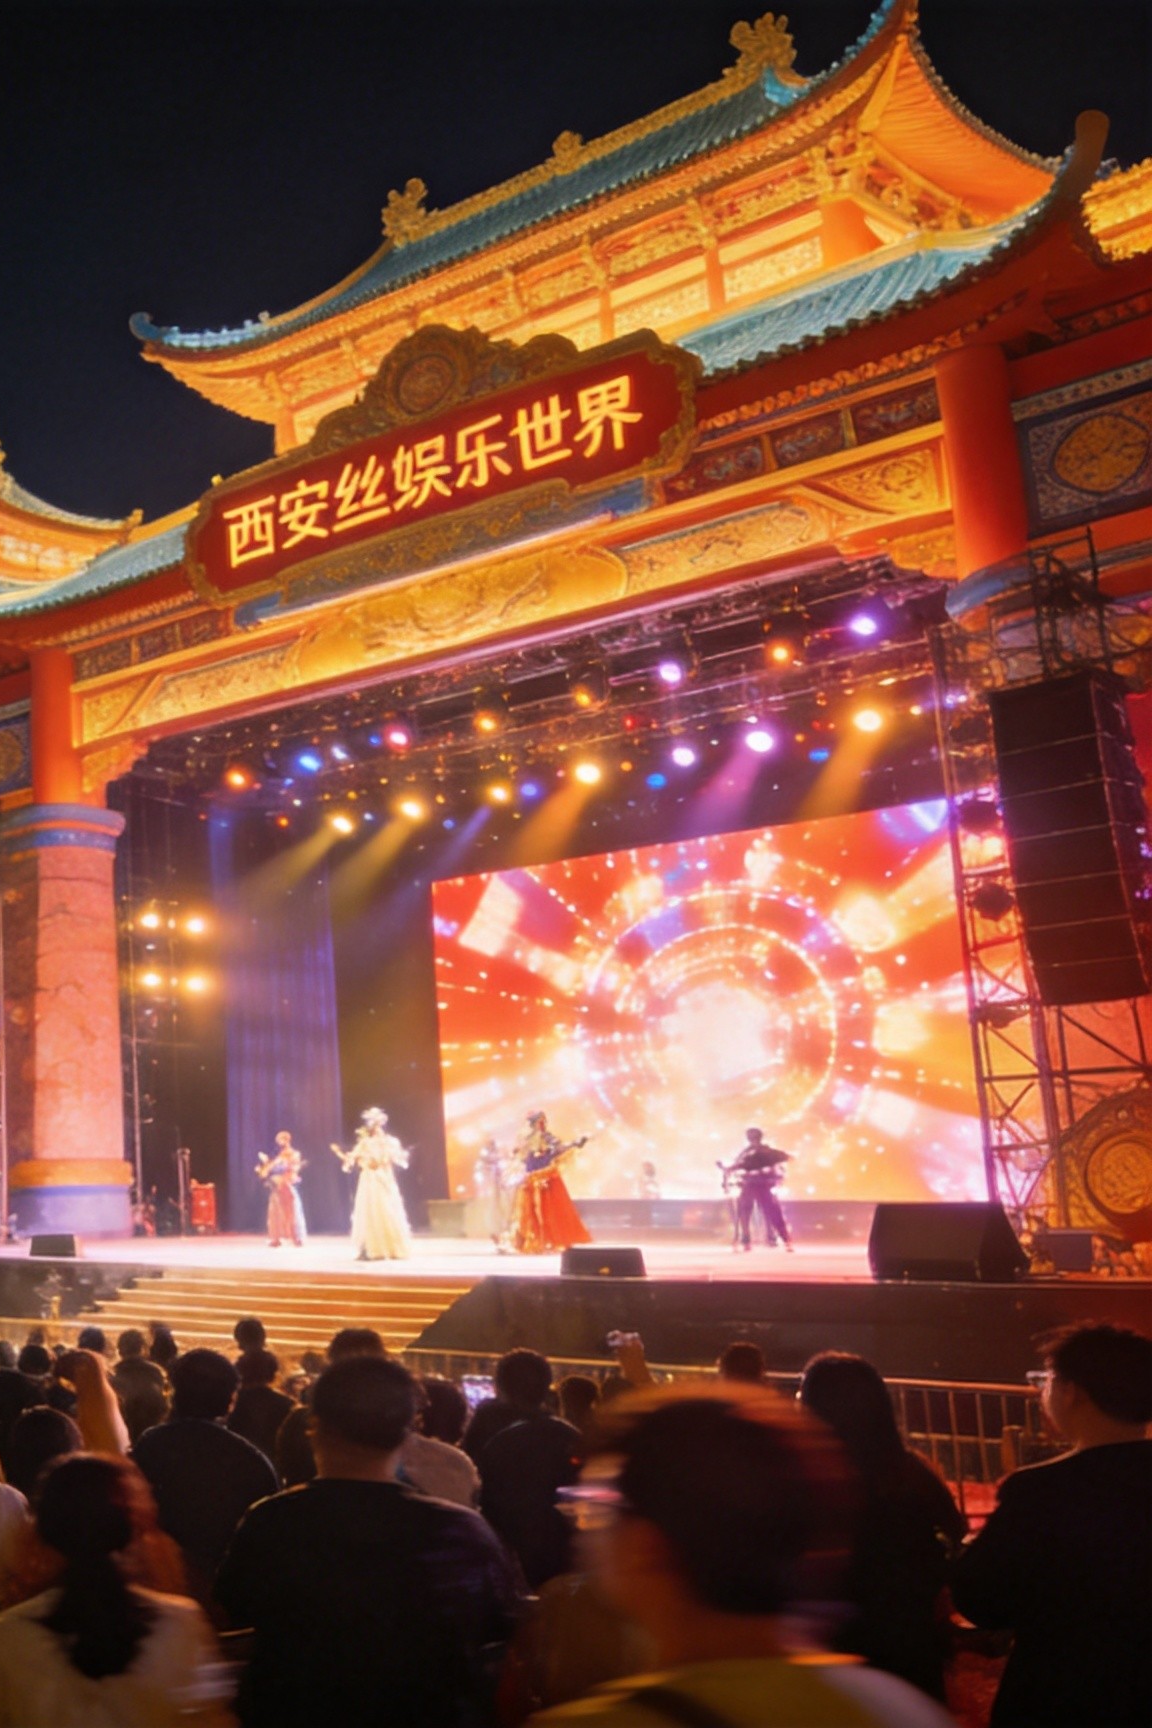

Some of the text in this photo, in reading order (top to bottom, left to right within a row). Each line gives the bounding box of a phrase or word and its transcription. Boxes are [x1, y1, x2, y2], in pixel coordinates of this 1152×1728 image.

[223, 376, 642, 568] 西安丝娱乐世界
